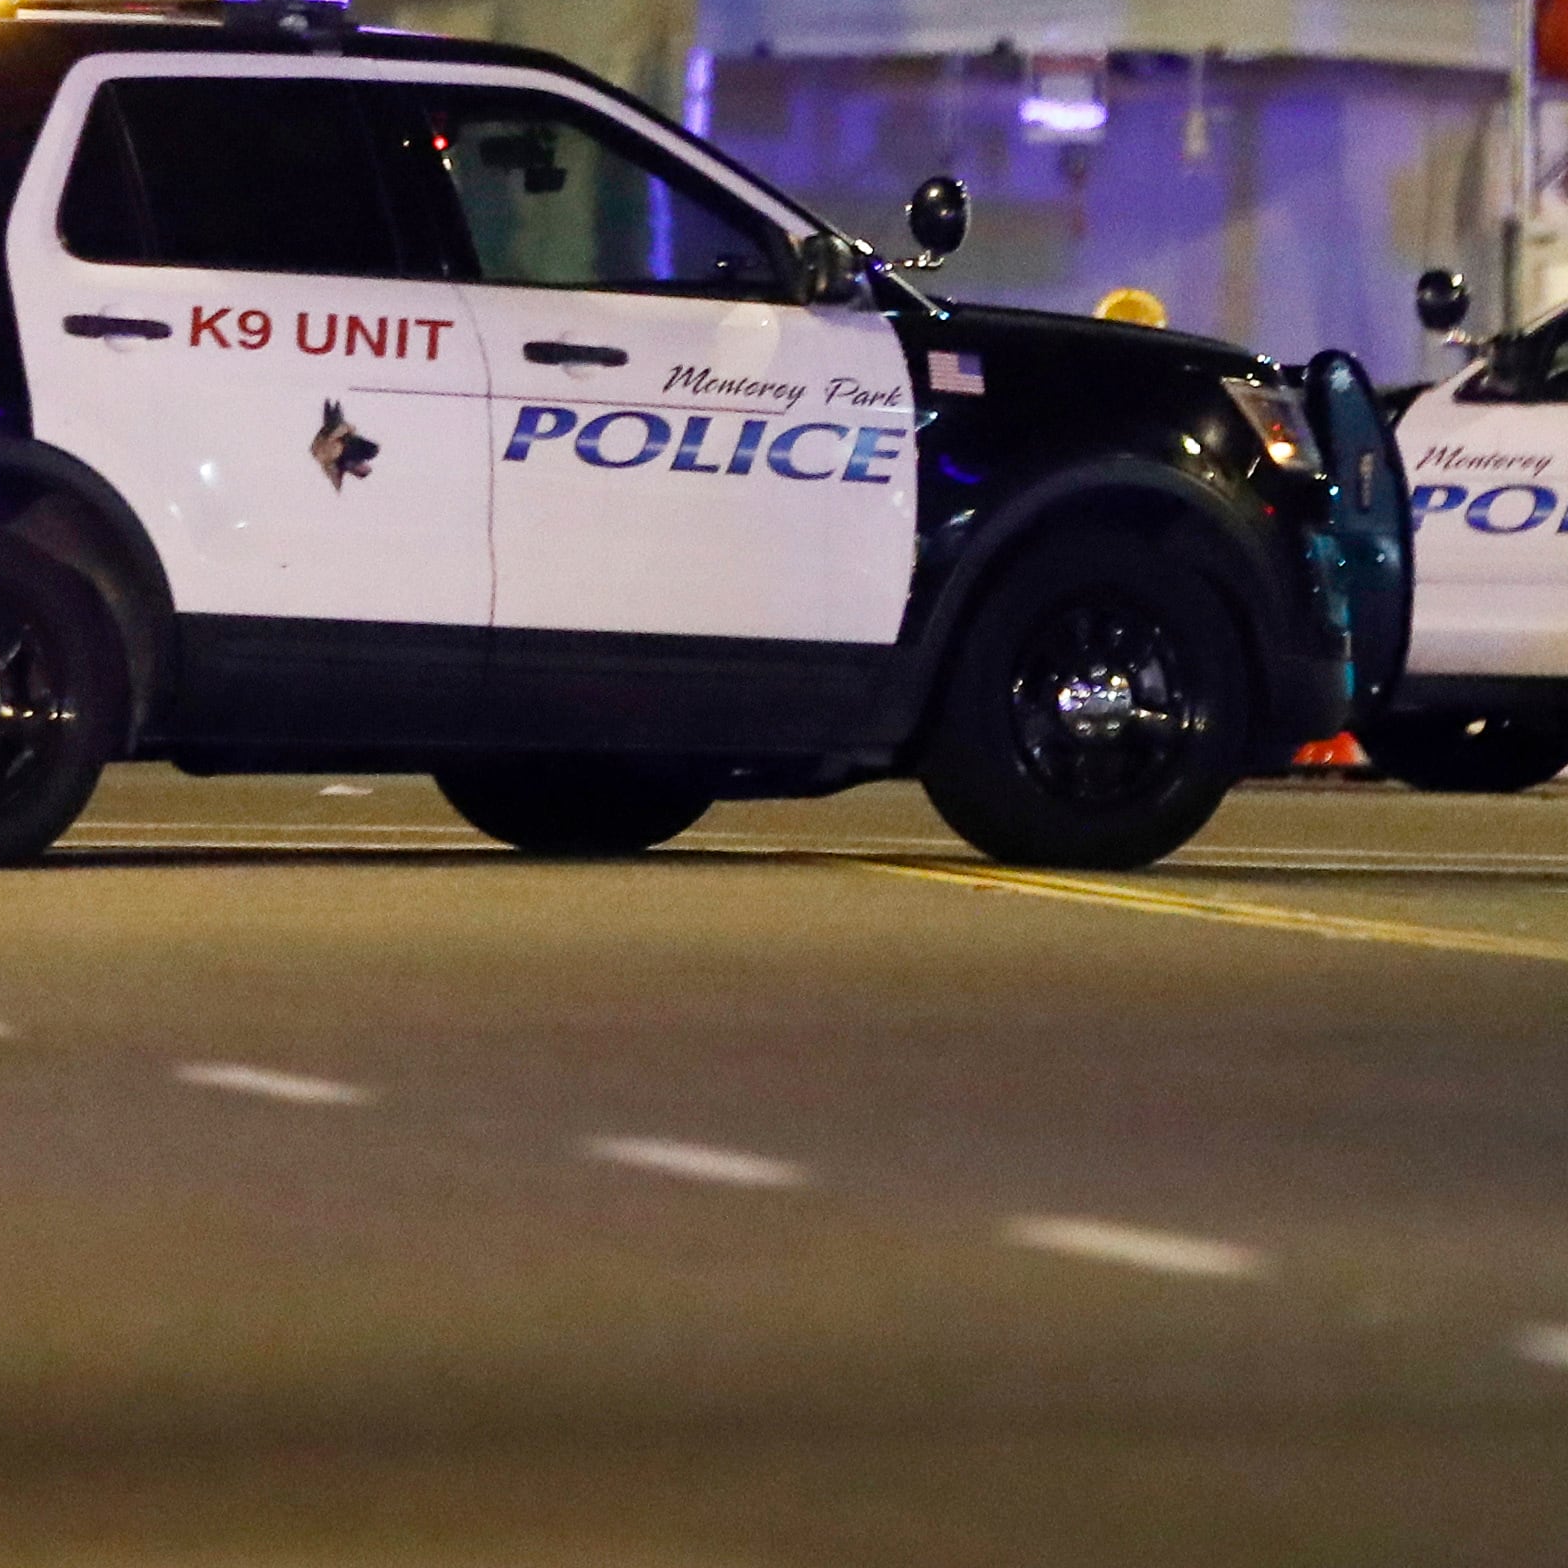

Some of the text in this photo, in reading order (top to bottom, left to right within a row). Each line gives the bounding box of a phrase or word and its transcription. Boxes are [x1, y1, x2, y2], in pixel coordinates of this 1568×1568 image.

[189, 305, 454, 362] K9 UNIT
[663, 363, 903, 409] Monterey Park
[503, 405, 907, 485] POLICE
[1414, 444, 1554, 478] Monterey
